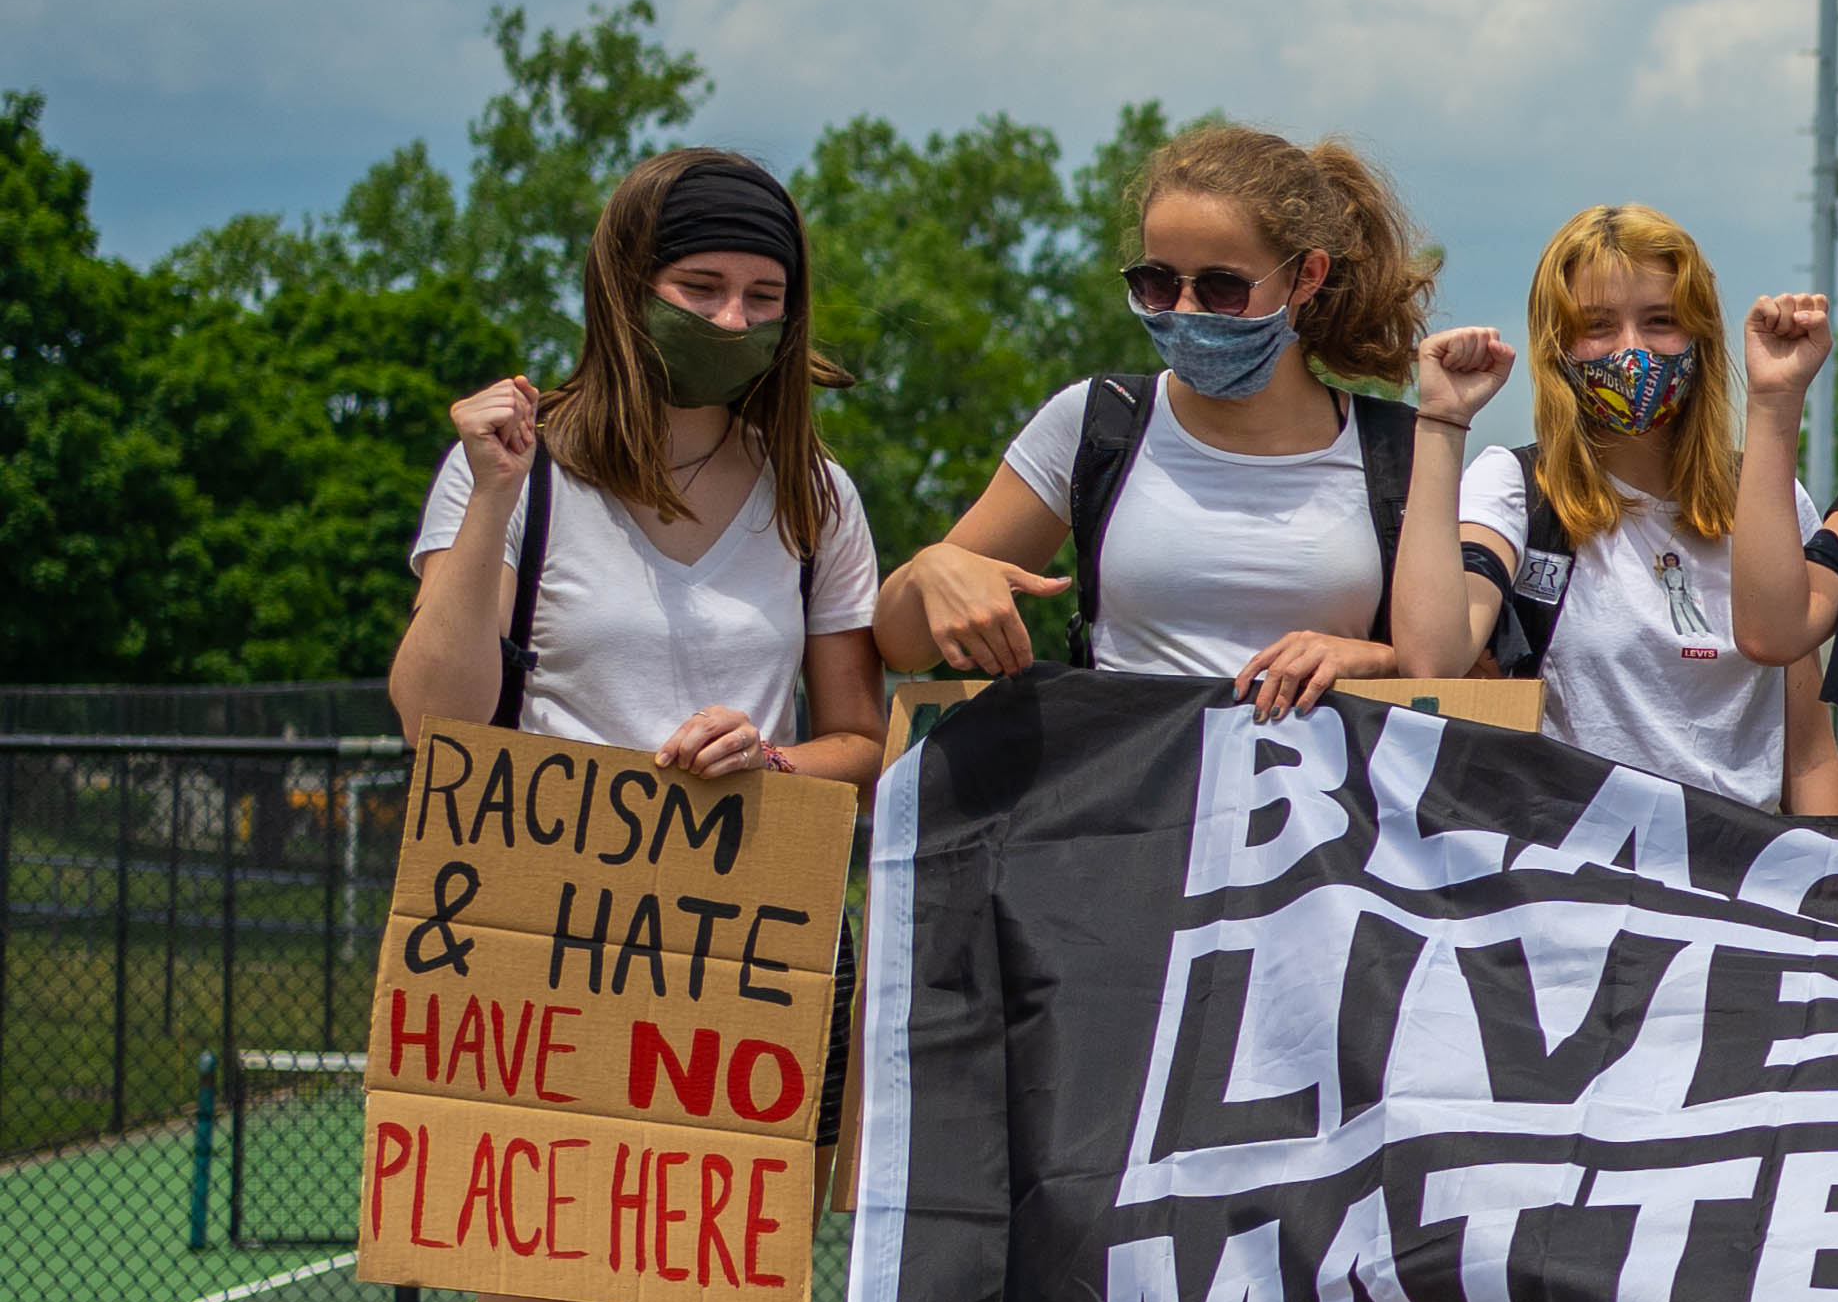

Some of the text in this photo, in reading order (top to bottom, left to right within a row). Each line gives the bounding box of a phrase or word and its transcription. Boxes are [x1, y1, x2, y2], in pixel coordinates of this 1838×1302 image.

[417, 733, 743, 874] RACISM
[404, 861, 811, 1006] & HATE
[389, 991, 804, 1123] HAVE NO
[373, 1123, 787, 1289] PLACE HERE
